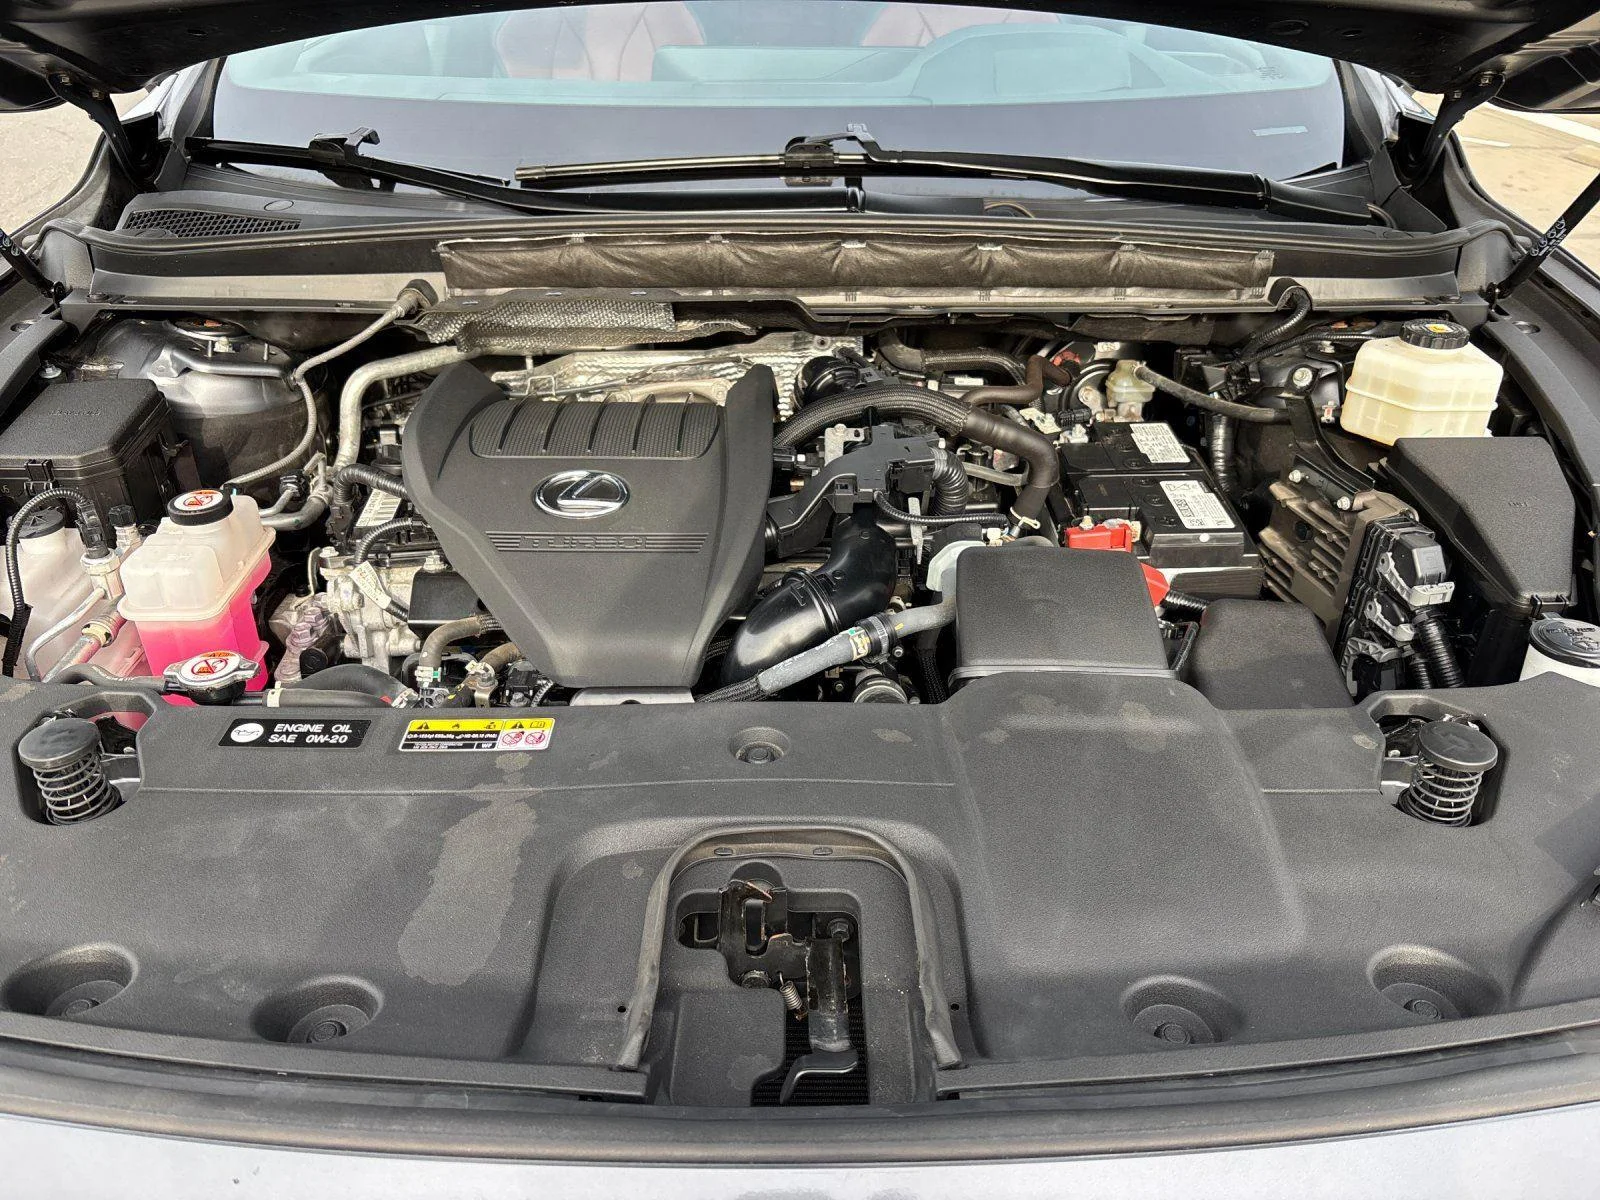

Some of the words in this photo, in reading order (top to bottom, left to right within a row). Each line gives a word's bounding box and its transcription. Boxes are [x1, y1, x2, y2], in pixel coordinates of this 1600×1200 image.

[522, 536, 643, 549] TURBO
[274, 723, 324, 733] ENGINE
[331, 724, 352, 733] OIL
[268, 734, 298, 743] SAE
[305, 734, 348, 743] 0W-20
